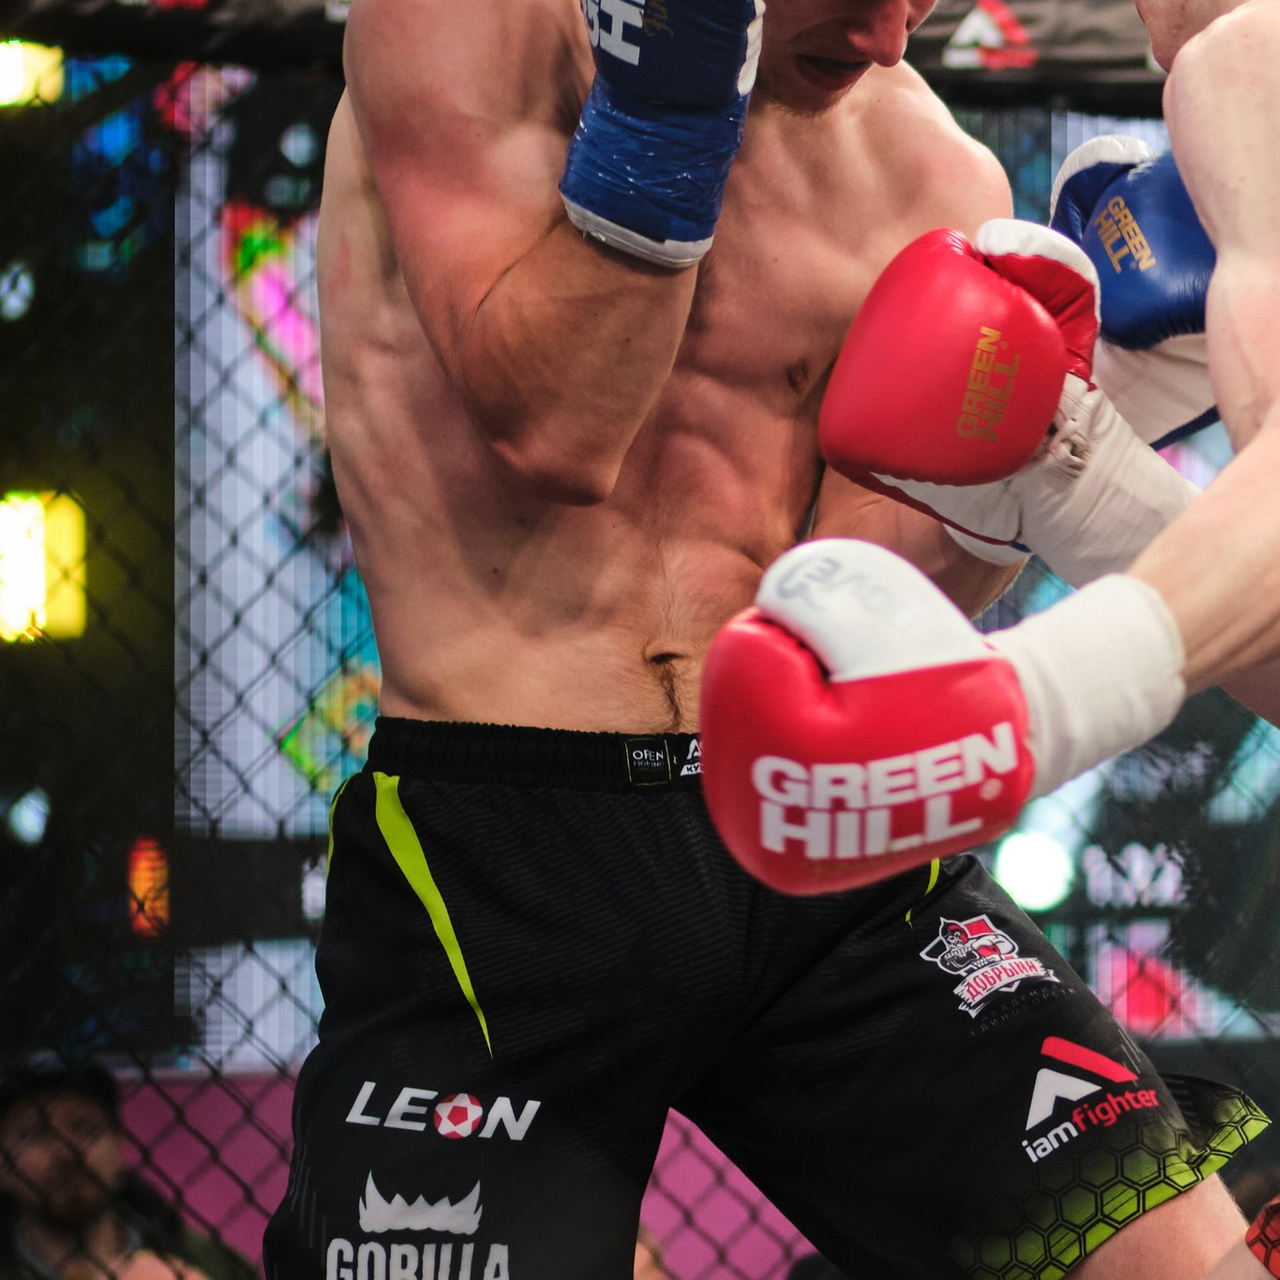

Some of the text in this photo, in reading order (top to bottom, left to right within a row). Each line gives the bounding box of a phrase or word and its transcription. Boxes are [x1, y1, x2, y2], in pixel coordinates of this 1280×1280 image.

[1094, 207, 1132, 274] HILL
[1108, 195, 1156, 271] GREEN
[957, 326, 1002, 439] GREEN
[973, 353, 1021, 441] HILL
[632, 749, 665, 761] OPEN
[752, 721, 1018, 810] GREEN
[760, 794, 984, 860] HILL
[966, 959, 1040, 1001] ДОБРЫНЯ
[345, 1081, 542, 1141] LEON
